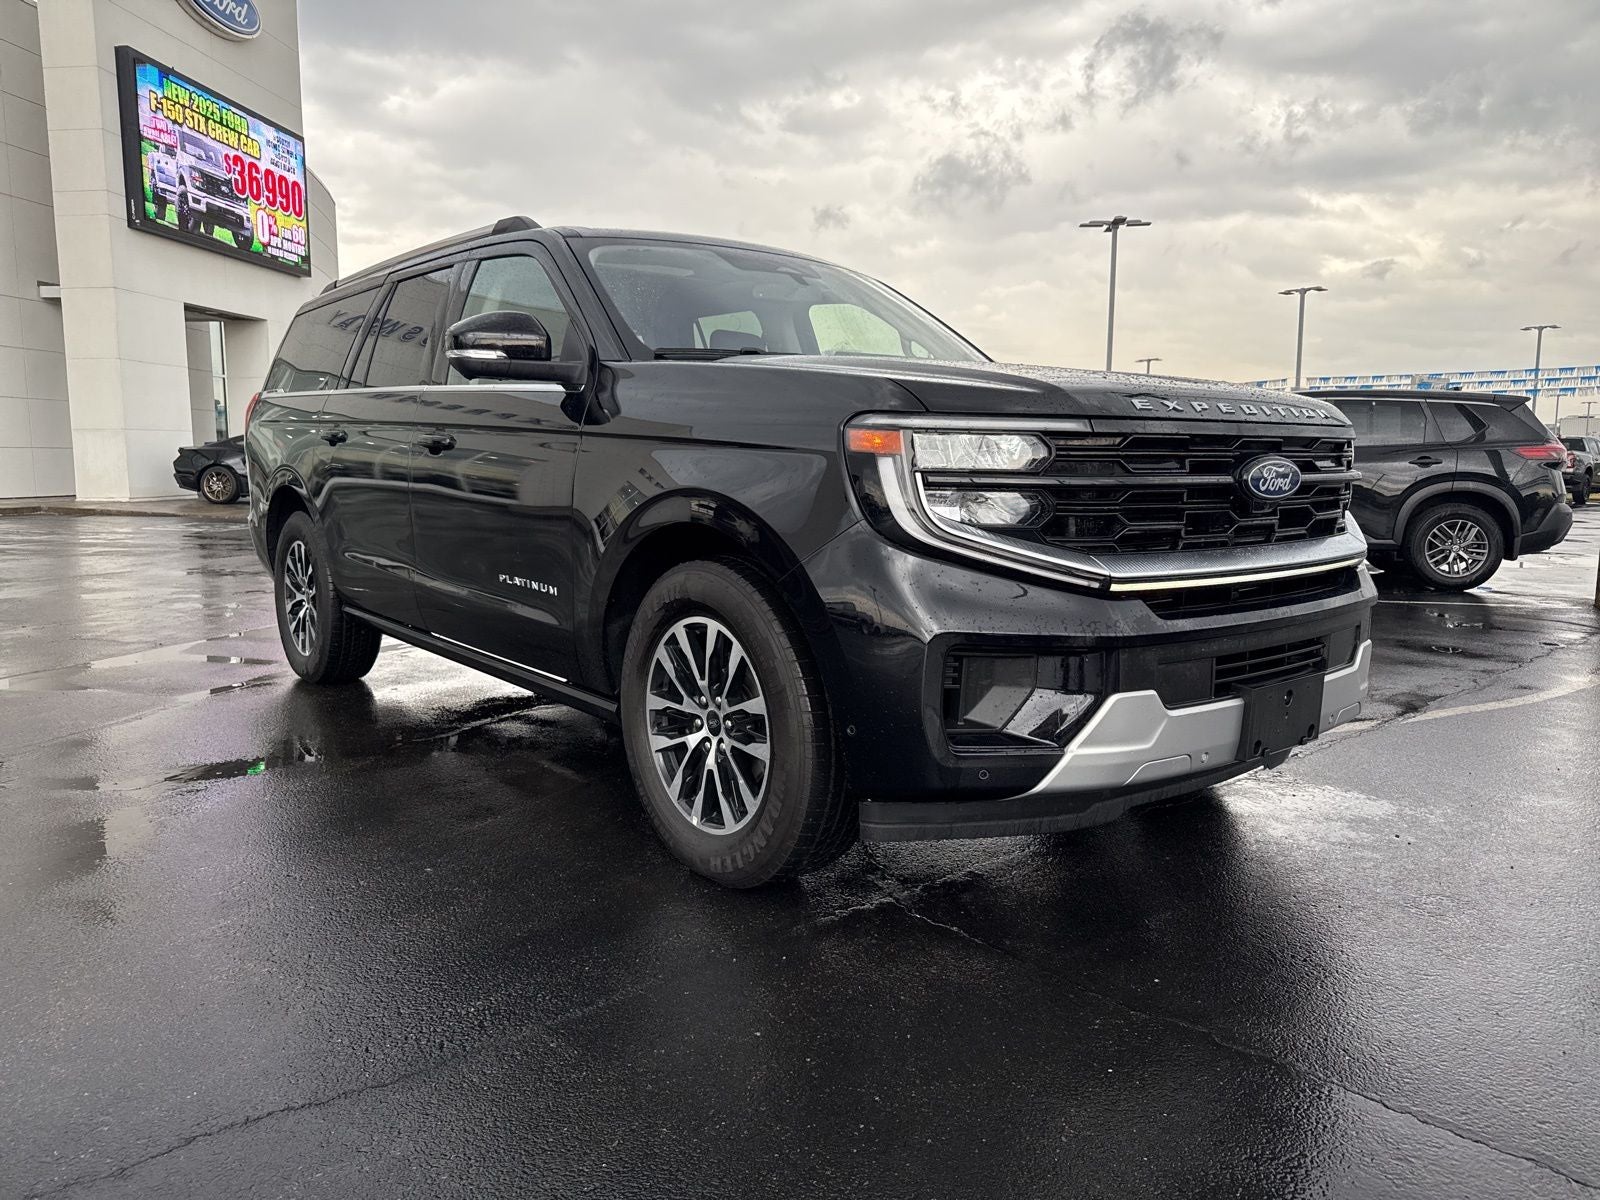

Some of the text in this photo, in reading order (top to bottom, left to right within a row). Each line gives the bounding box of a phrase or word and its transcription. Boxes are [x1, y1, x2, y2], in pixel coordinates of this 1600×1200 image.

[164, 78, 248, 136] NEW 2025 FORD
[150, 91, 184, 125] F-150
[185, 108, 207, 135] STX
[207, 118, 239, 150] CREW
[240, 134, 260, 159] CAB
[1131, 399, 1331, 419] EXPEDITION
[1259, 465, 1292, 491] Ford
[498, 573, 558, 596] PLATINUM
